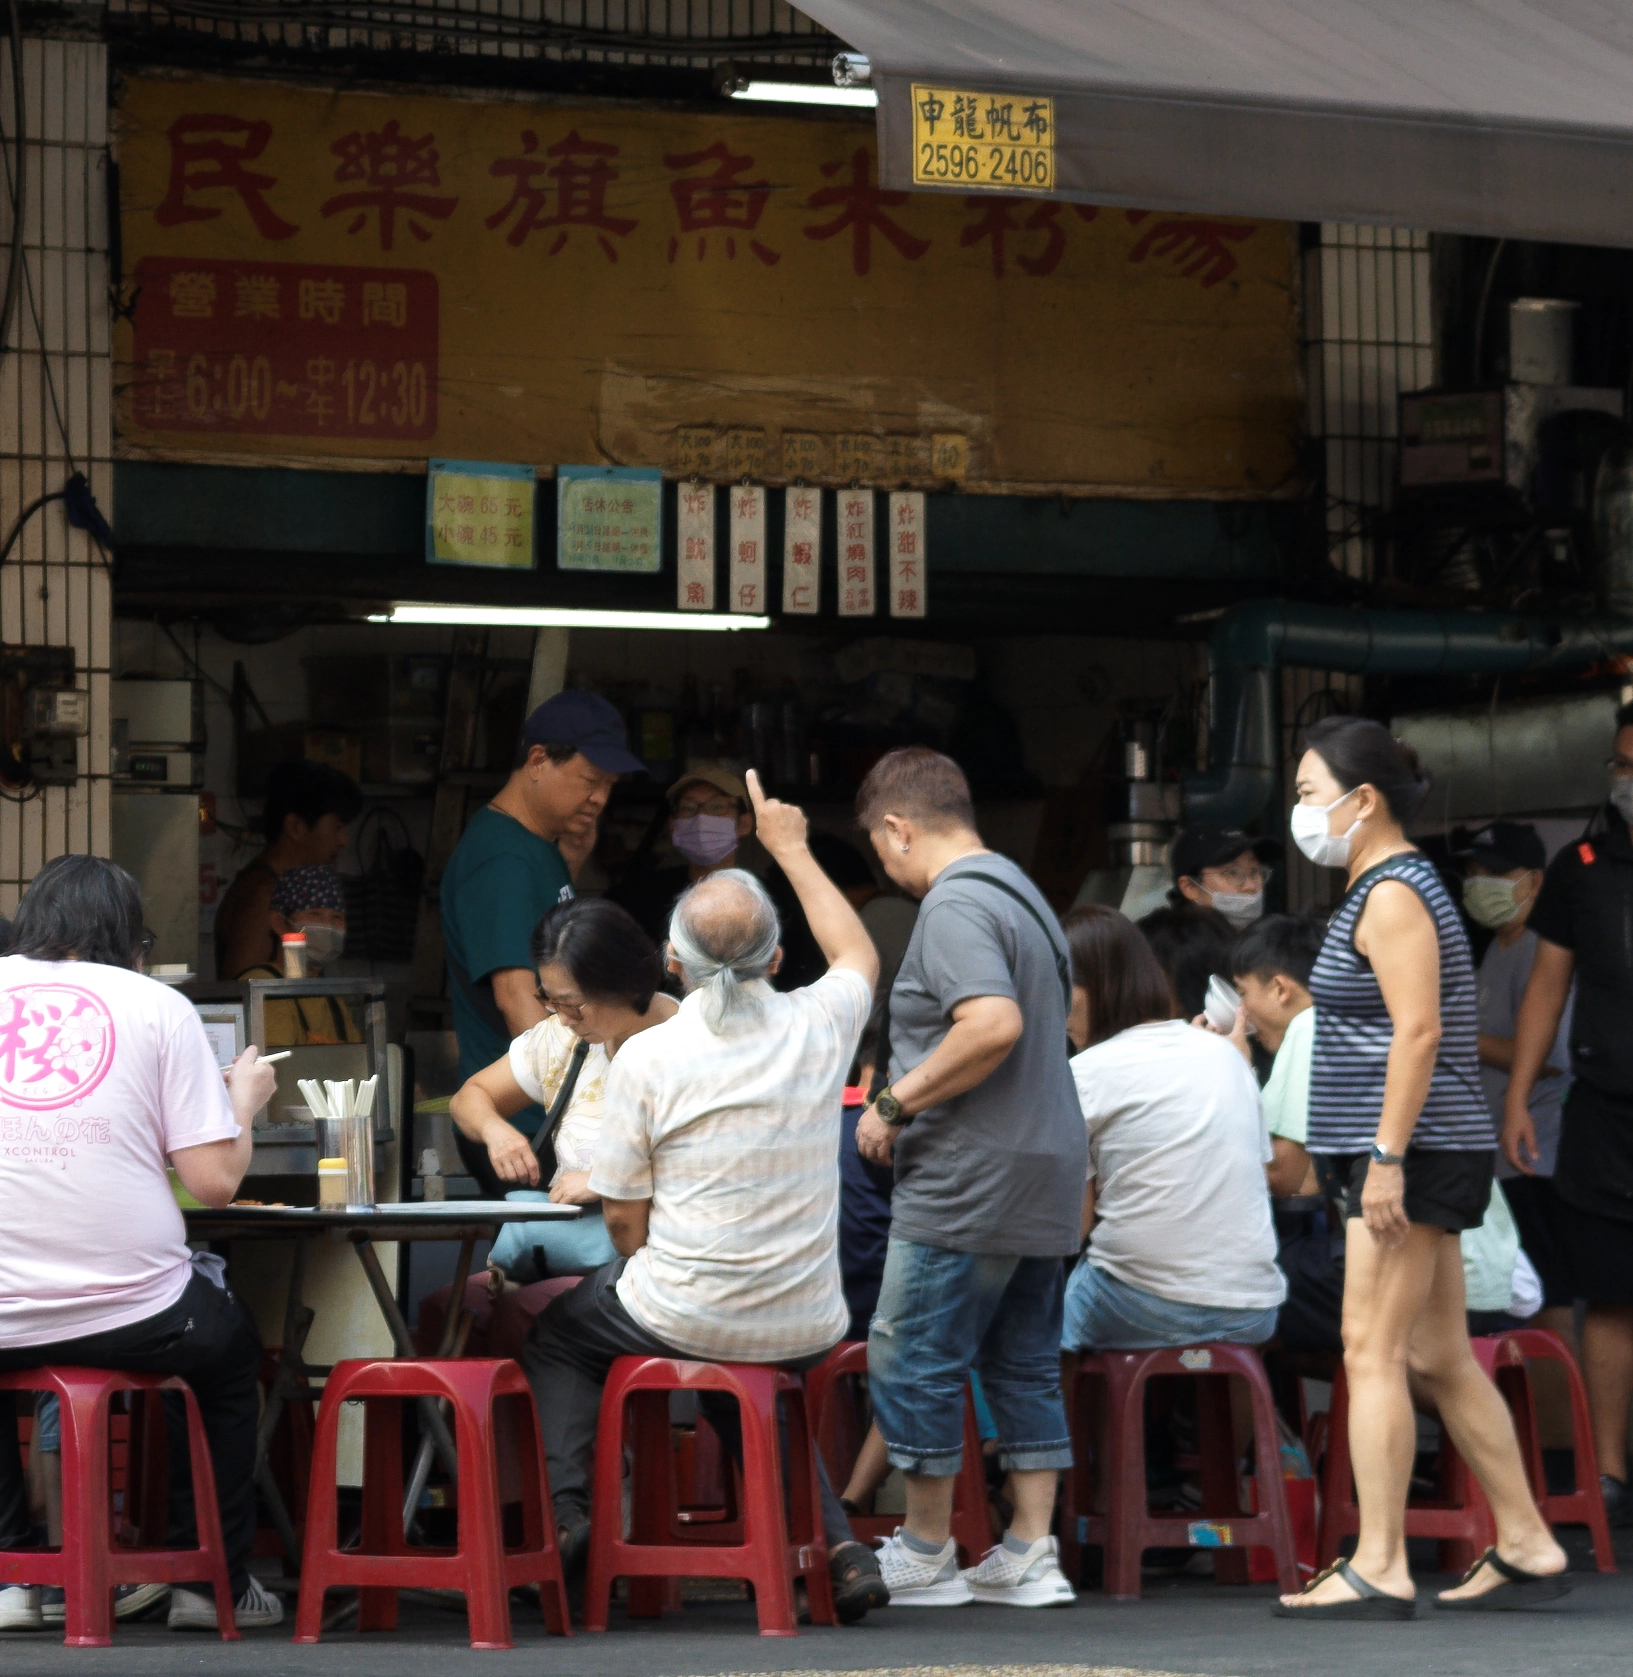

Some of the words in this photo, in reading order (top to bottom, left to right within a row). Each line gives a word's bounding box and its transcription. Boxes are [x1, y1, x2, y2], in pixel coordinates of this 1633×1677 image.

[918, 91, 1048, 144] 申龍帆布
[168, 270, 407, 330] 營業時間
[896, 503, 918, 612] 炸甜不辣
